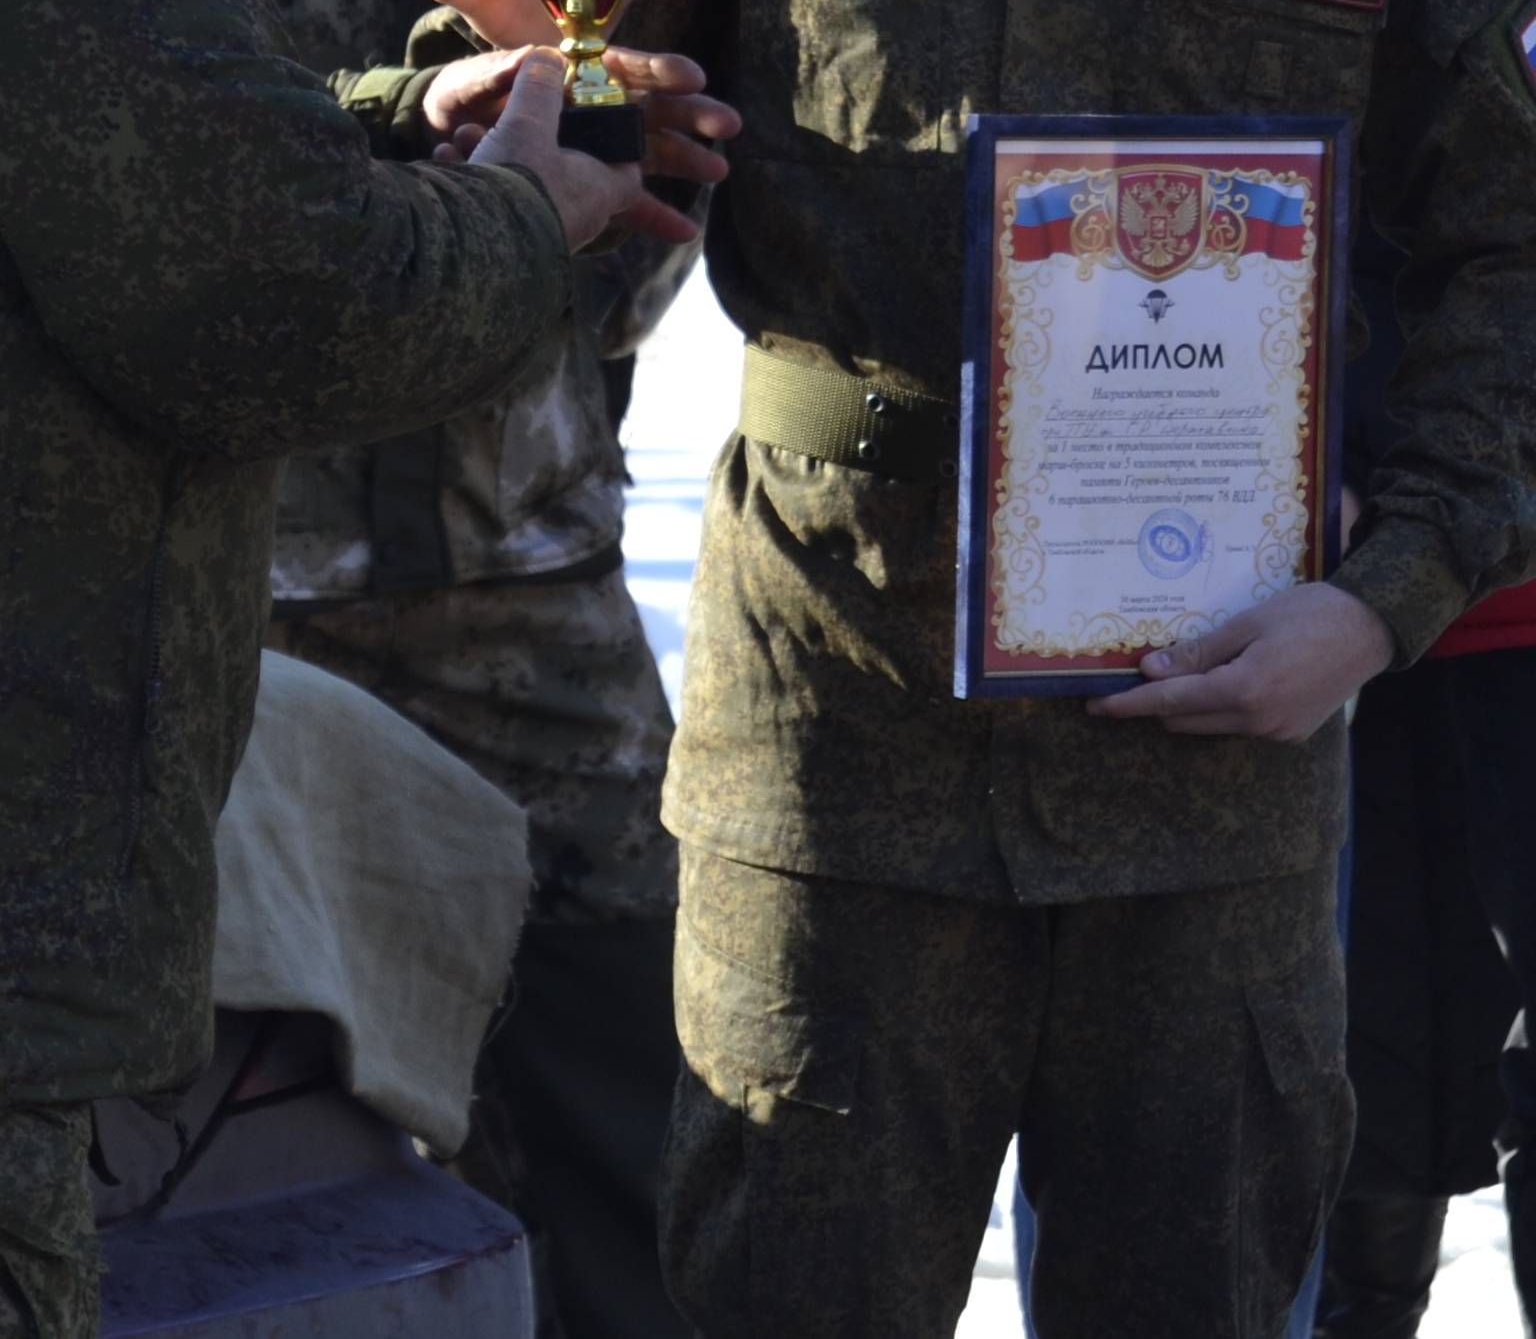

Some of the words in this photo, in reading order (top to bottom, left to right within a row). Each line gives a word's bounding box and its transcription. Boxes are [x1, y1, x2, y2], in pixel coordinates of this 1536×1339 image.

[1085, 343, 1224, 373] ДИПЛОМ
[1092, 387, 1172, 402] Награждается
[1176, 386, 1219, 398] команда
[1071, 443, 1104, 453] место
[1115, 441, 1192, 455] традиционном
[1195, 441, 1262, 451] комплексном
[1037, 458, 1106, 474] марш-броске
[1108, 461, 1121, 469] на
[1080, 478, 1121, 487] памяти
[1124, 474, 1230, 490] Героев-десантников
[1048, 493, 1055, 505] 6
[1057, 491, 1182, 509] парашютно-десантной
[1183, 494, 1213, 507] роты
[1218, 490, 1230, 502] 76
